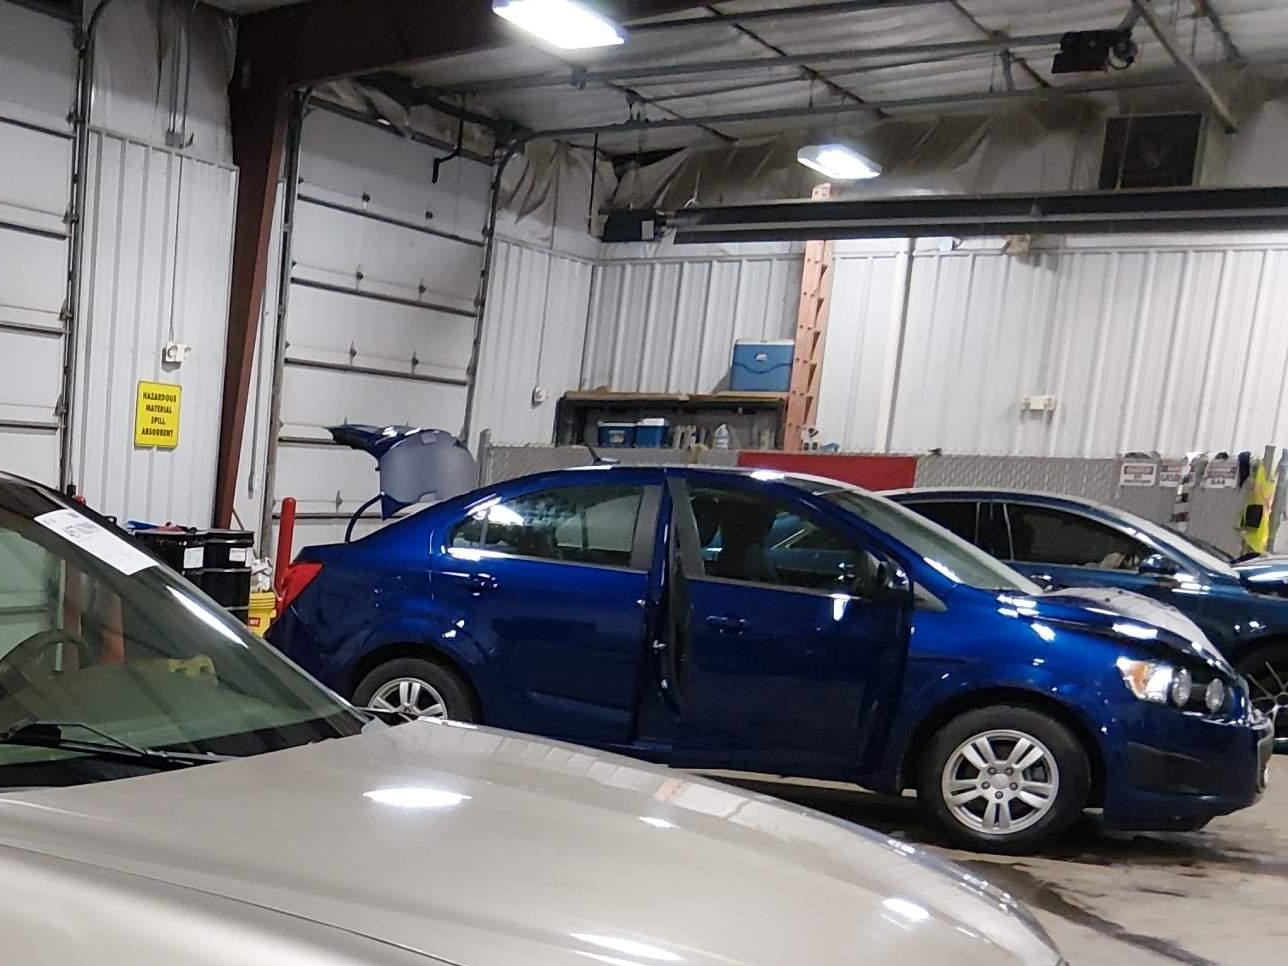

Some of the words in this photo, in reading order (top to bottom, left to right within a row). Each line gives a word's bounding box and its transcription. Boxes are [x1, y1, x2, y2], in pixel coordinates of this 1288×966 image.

[143, 392, 176, 402] HAZARDOUS
[146, 404, 172, 414] MATERIAL
[151, 416, 165, 425] SPILL
[141, 427, 173, 437] ABSORBENT
